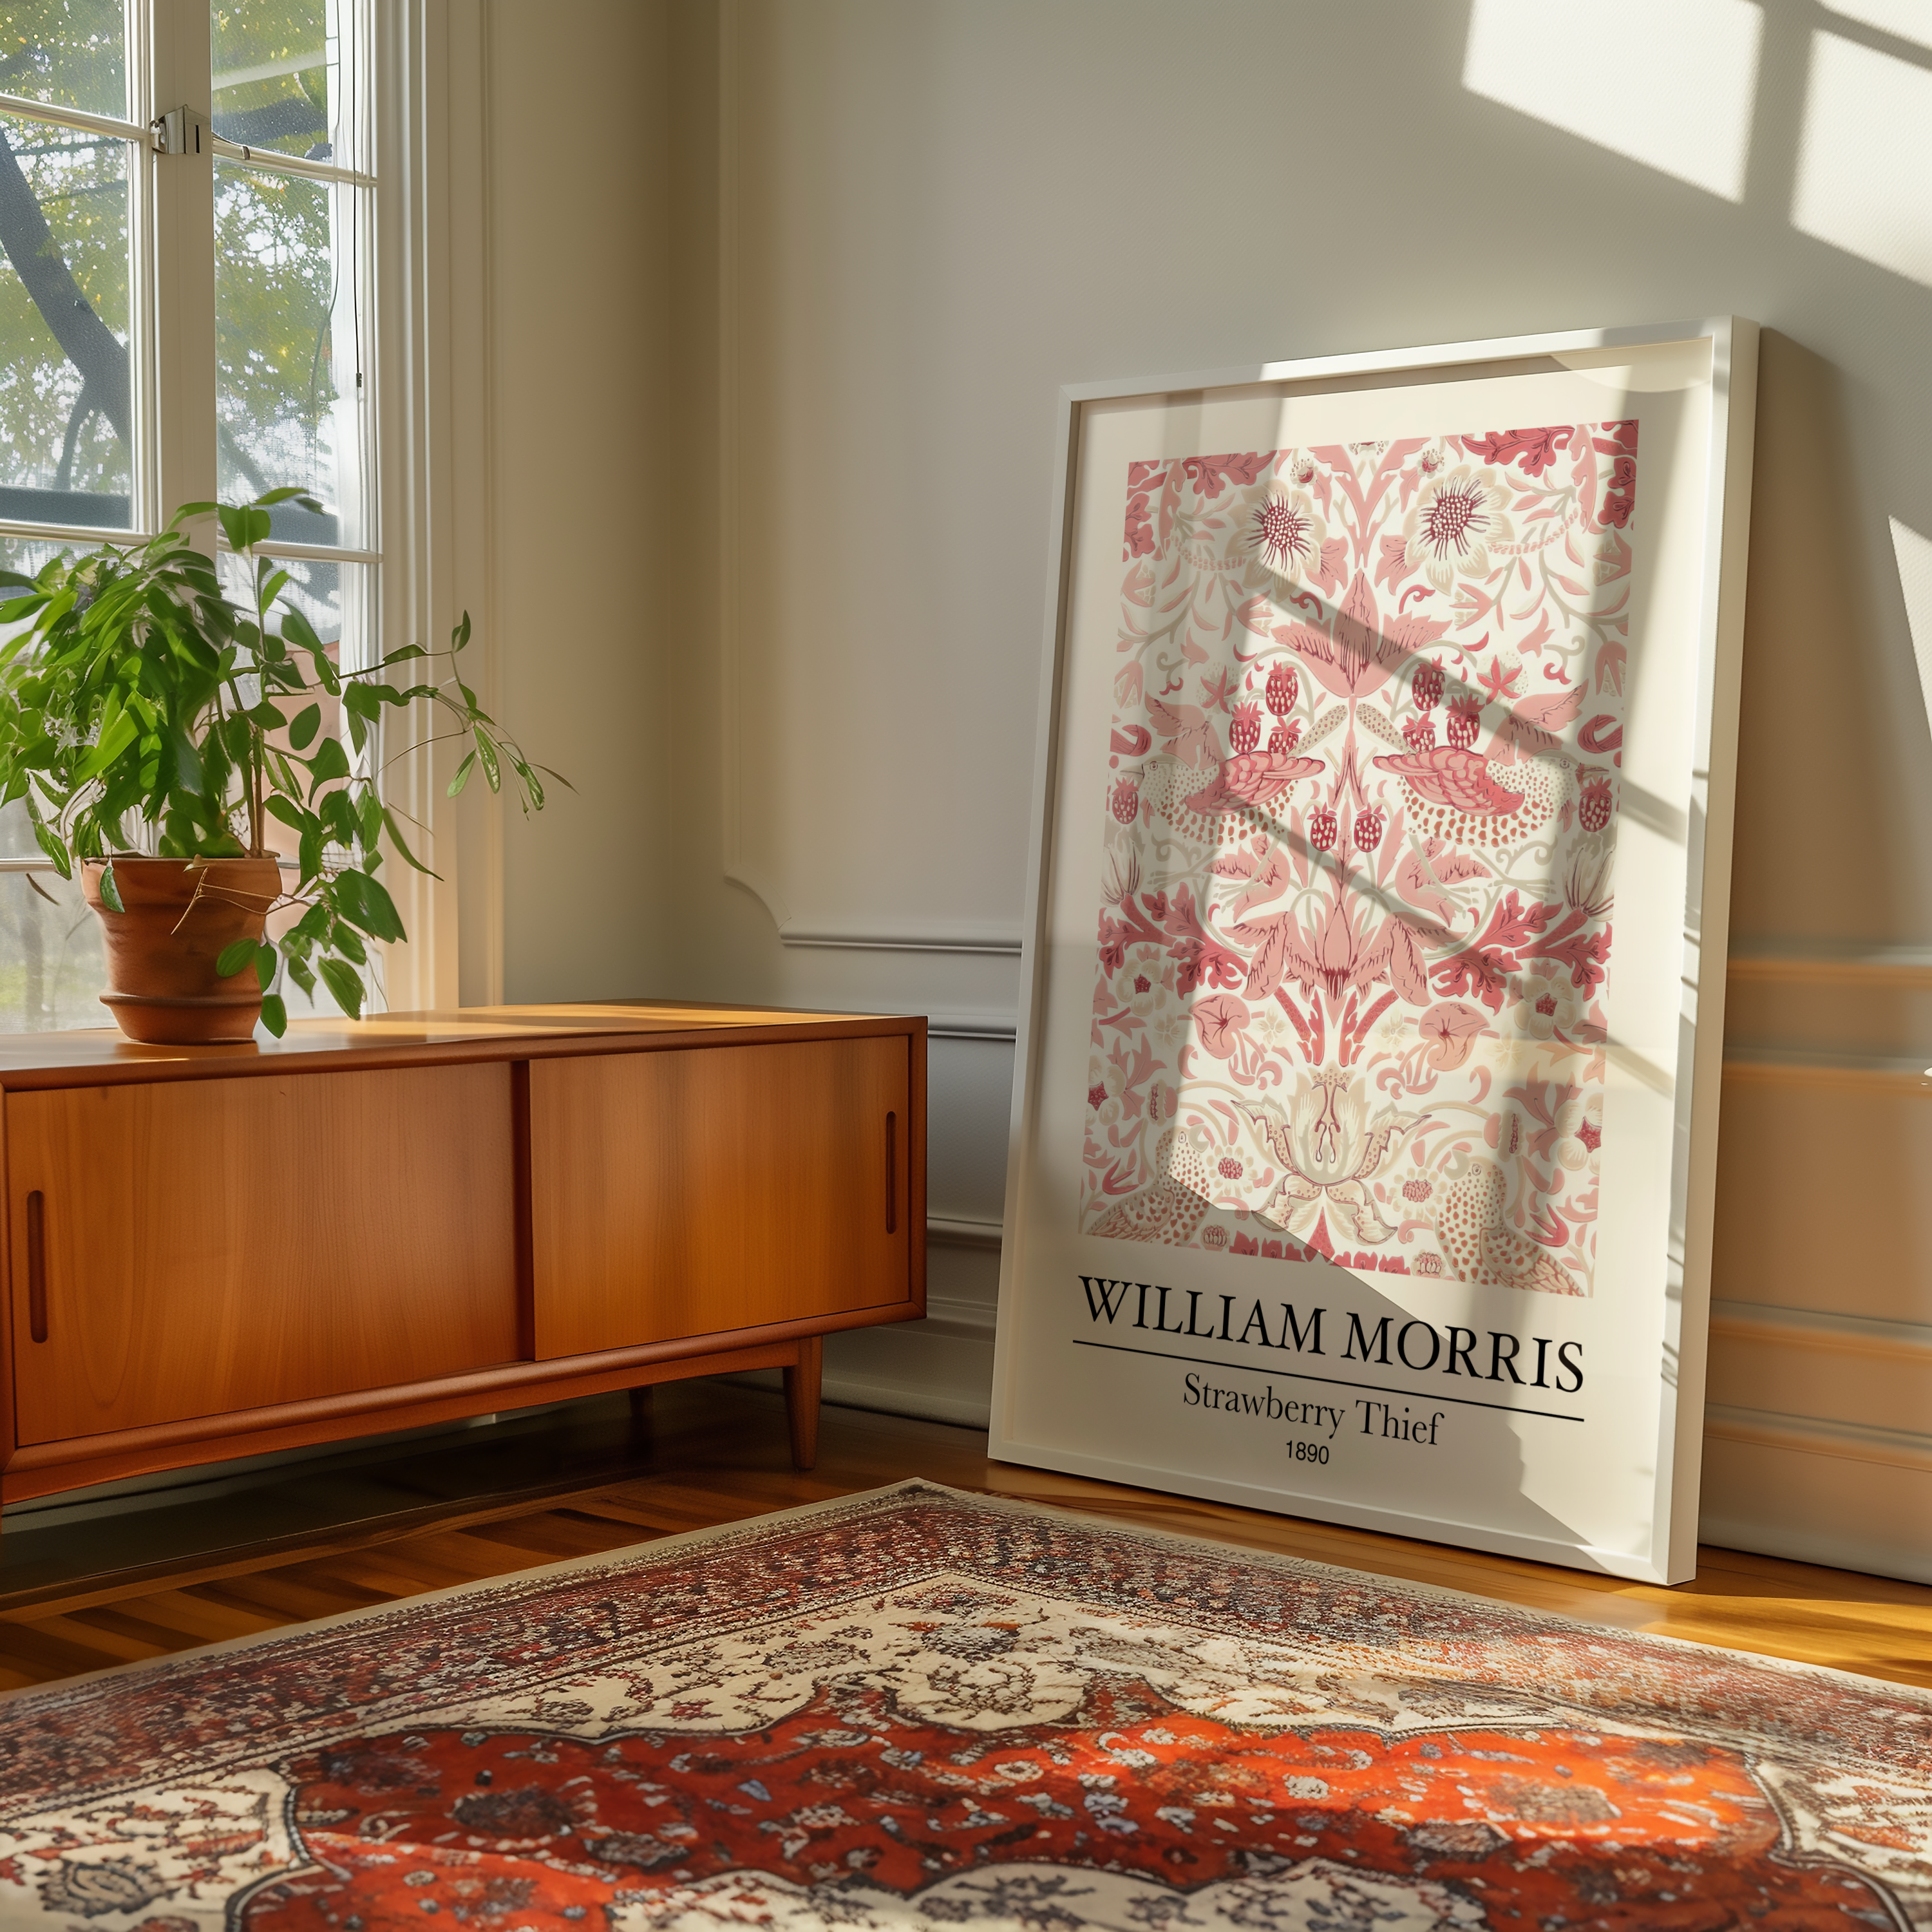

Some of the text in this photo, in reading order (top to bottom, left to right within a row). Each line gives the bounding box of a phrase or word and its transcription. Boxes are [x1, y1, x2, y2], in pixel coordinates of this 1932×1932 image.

[1078, 1275, 1584, 1393] WILLIAM MORRIS
[1183, 1372, 1445, 1446] Strawberry Thief
[1285, 1439, 1330, 1465] 1890
